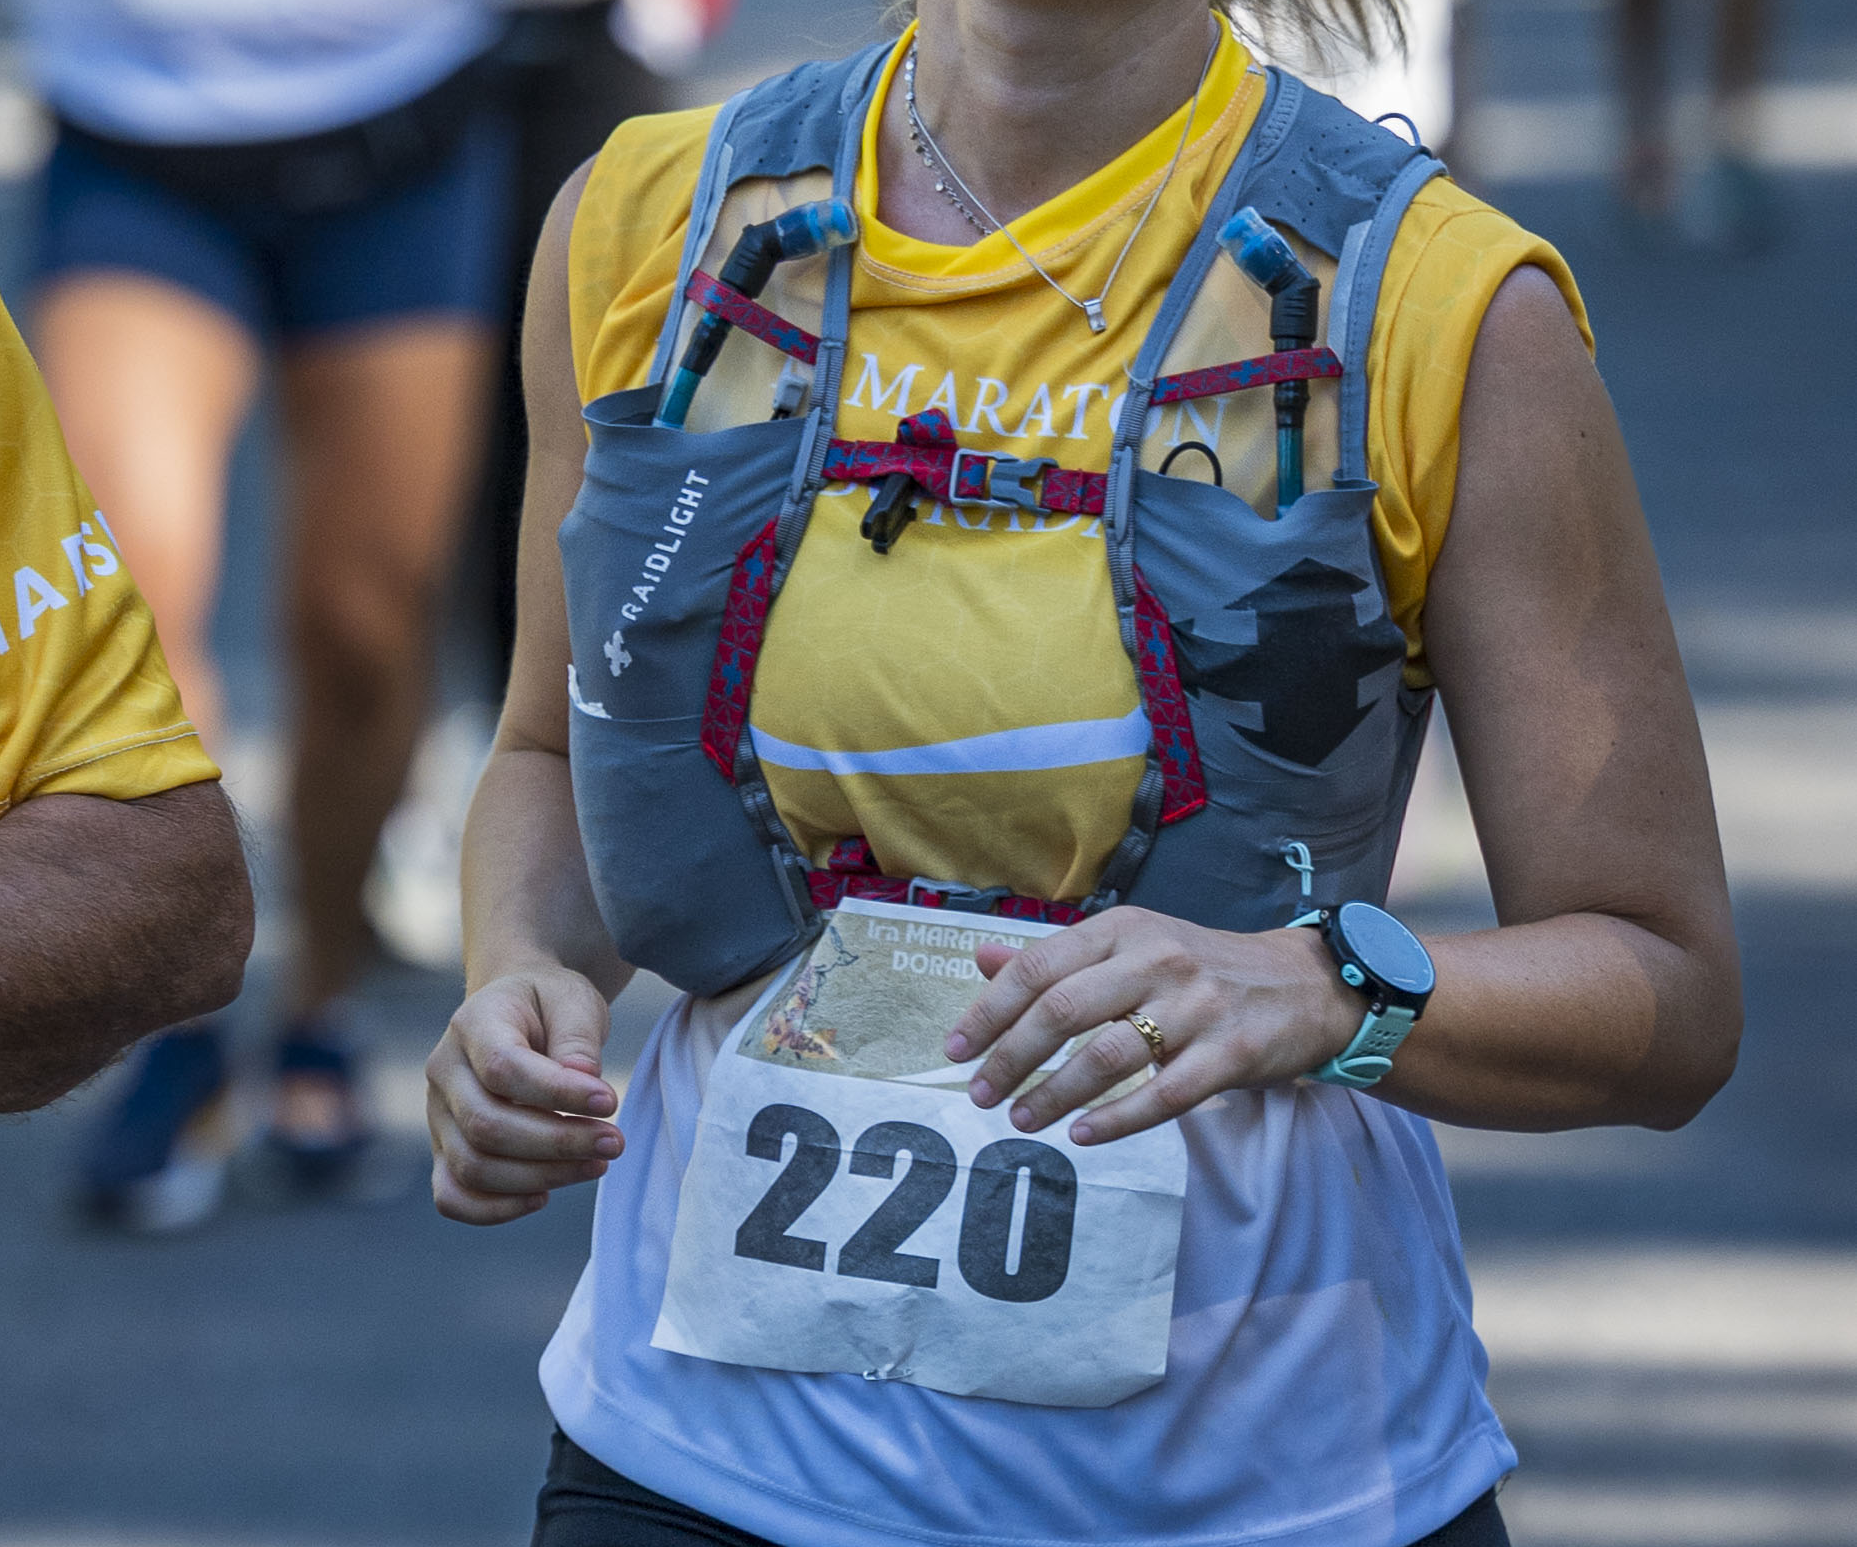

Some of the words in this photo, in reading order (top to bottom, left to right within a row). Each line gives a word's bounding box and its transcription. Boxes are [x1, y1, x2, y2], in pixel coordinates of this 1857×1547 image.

[621, 469, 710, 622] RAIDLIGHT
[893, 950, 988, 983] DORAD
[735, 1103, 1078, 1303] 220
